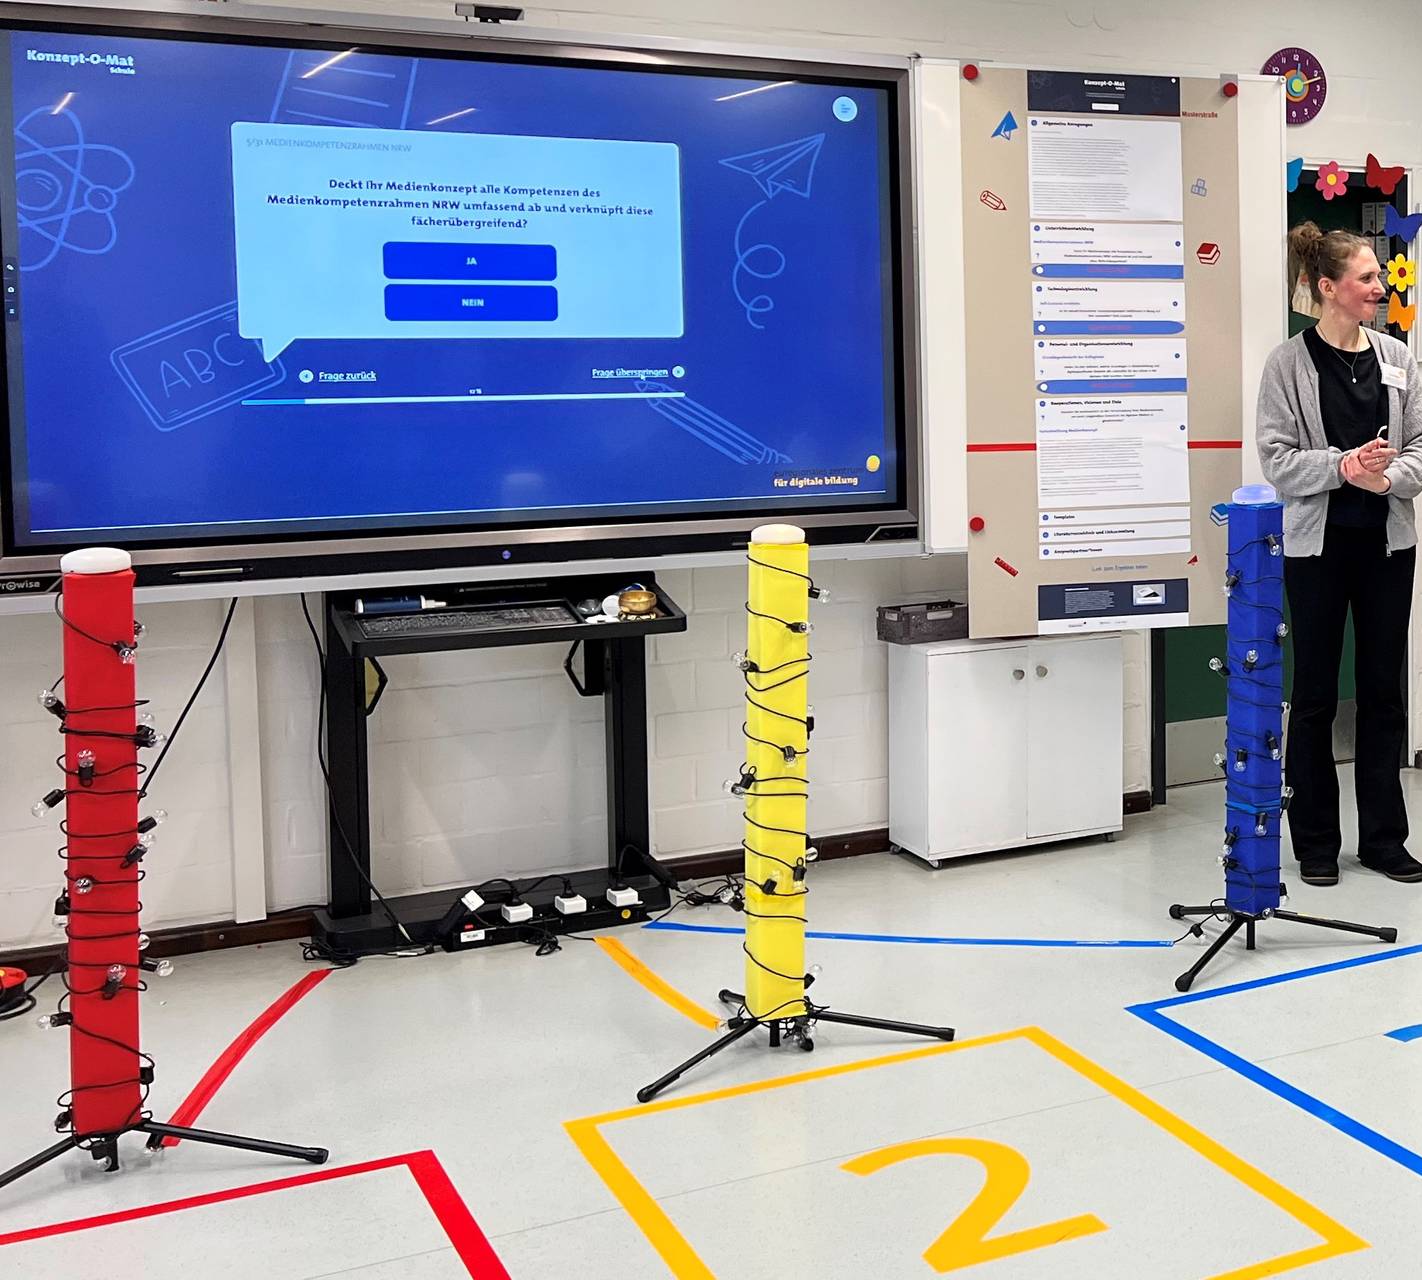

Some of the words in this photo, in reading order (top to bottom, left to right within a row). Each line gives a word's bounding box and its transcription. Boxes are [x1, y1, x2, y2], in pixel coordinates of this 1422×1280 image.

[26, 49, 135, 66] Konzept-O-Mat
[329, 179, 363, 190] Deckt
[366, 180, 383, 191] Ihr
[386, 181, 478, 197] Medienkonzept
[480, 184, 501, 195] alle
[503, 185, 580, 198] Kompetenzen
[582, 187, 601, 198] des
[267, 194, 430, 210] Medienkompetenzrahmen
[432, 199, 460, 210] NRW
[463, 202, 526, 213] umfassend
[528, 203, 542, 213] ab
[545, 203, 567, 214] und
[569, 204, 624, 218] verknüpft
[626, 206, 654, 216] diese
[411, 215, 528, 230] fächerübergreifend?
[465, 256, 478, 266] JA
[461, 298, 485, 307] NEIN
[160, 332, 245, 398] ABC
[318, 371, 345, 383] Frage
[345, 370, 377, 383] zurück
[591, 368, 614, 379] Frage
[615, 367, 669, 379] überspringen
[773, 478, 788, 488] für
[789, 476, 824, 489] digitale
[824, 475, 859, 486] bildung
[0, 579, 41, 591] rowise
[838, 1137, 1110, 1274] 2
